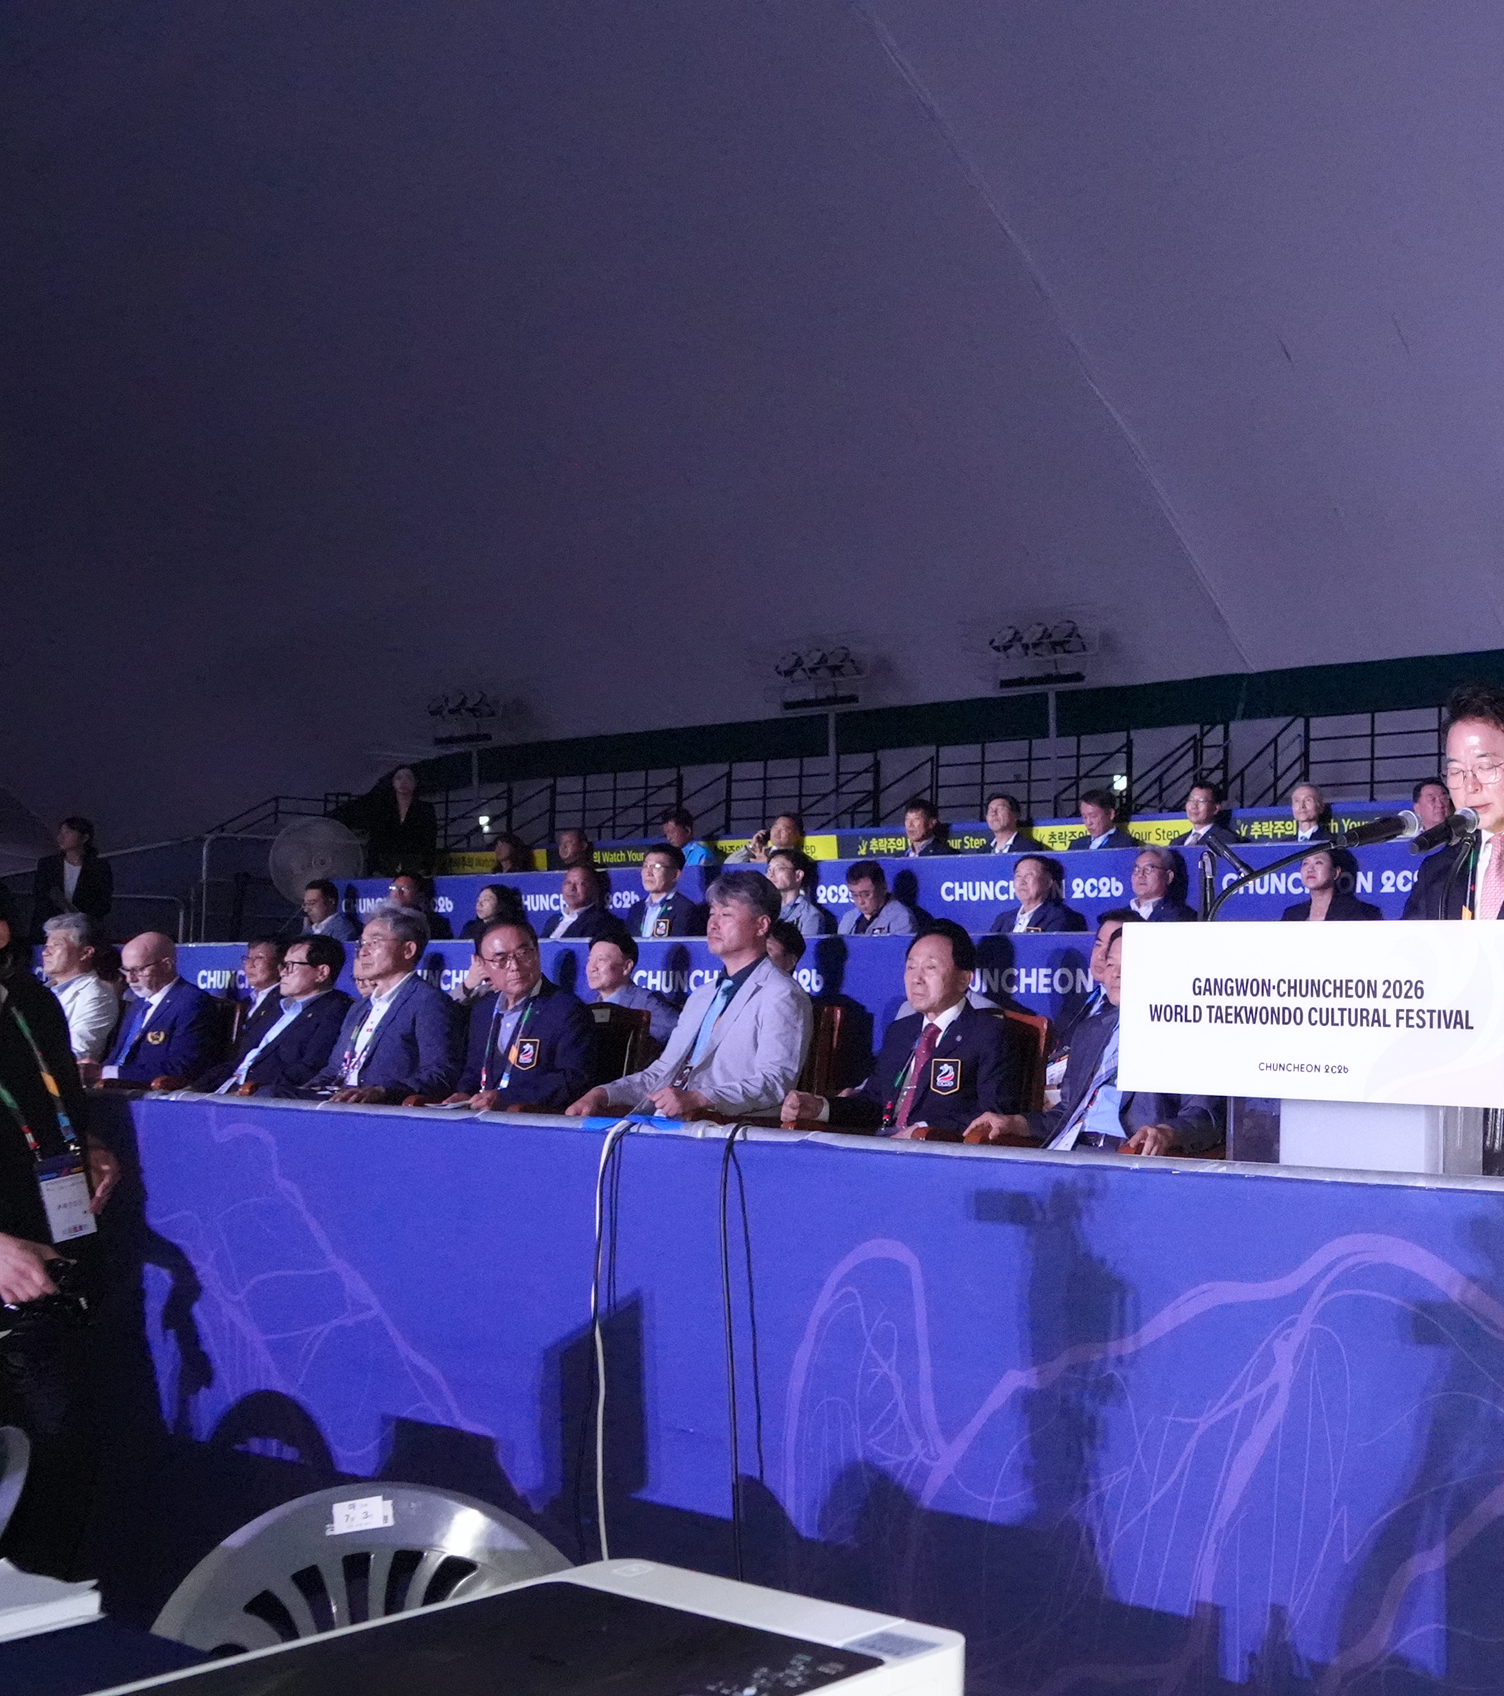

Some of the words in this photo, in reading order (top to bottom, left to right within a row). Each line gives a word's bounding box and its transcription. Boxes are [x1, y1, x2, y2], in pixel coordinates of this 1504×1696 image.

[1250, 820, 1297, 839] 추락주의
[869, 837, 906, 855] 추락주의
[602, 851, 626, 864] Watch
[627, 849, 645, 862] Your
[1222, 870, 1373, 895] CHUNCON
[968, 967, 1095, 994] UNCHEON
[1381, 978, 1425, 1000] 2026
[1149, 1003, 1202, 1024] WORLD
[1206, 1004, 1304, 1026] TAEKWONDO
[1308, 1006, 1391, 1029] CULTURAL
[1395, 1008, 1474, 1031] FESTIVAL
[1258, 1061, 1321, 1074] CHUNCHEON
